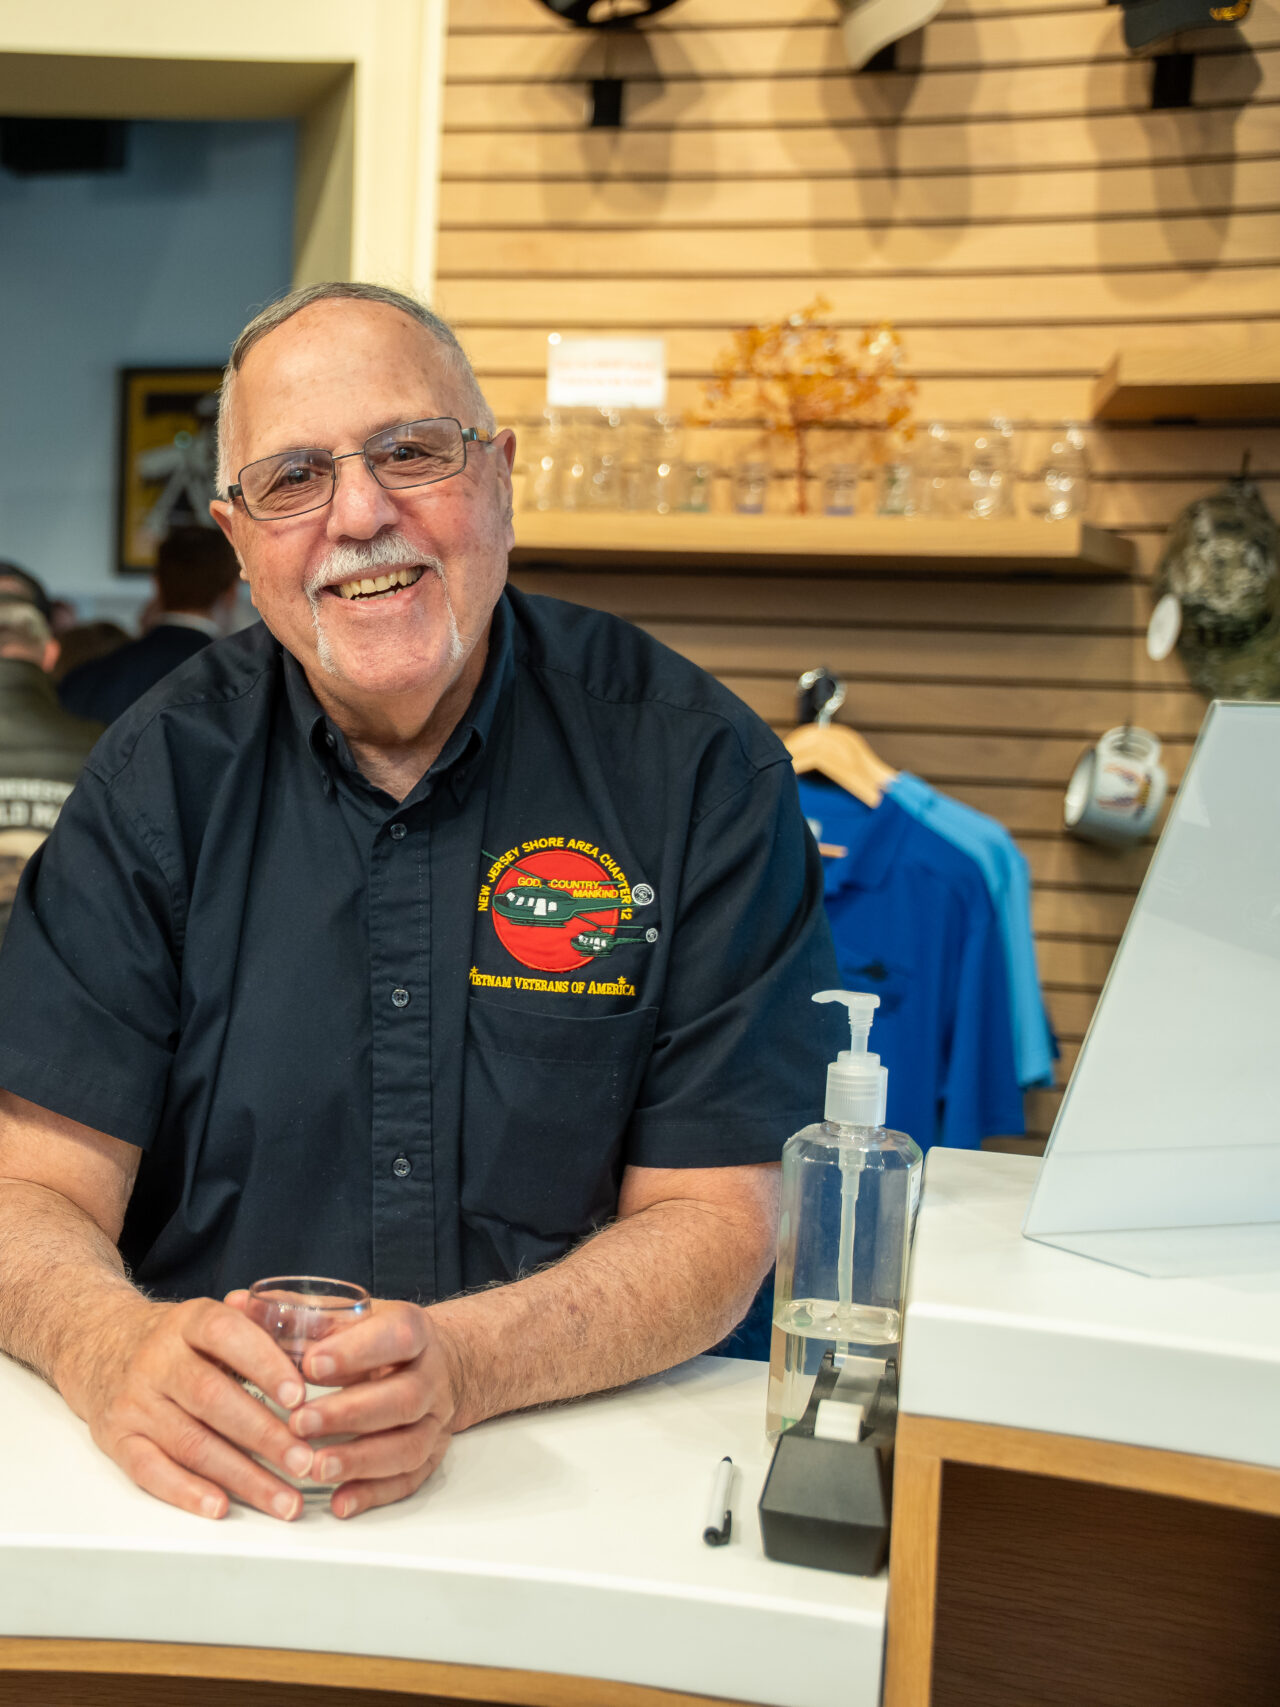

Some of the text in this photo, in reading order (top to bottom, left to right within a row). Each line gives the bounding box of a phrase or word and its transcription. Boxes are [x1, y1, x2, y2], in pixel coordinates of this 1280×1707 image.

[478, 837, 633, 920] NEW JERSEY SHORE AREA CHAPTER 12
[517, 877, 542, 889] GOD,
[573, 889, 619, 899] MANKIND
[514, 977, 570, 993] VETERANS
[571, 981, 585, 994] OF
[588, 981, 636, 996] AMERICA
